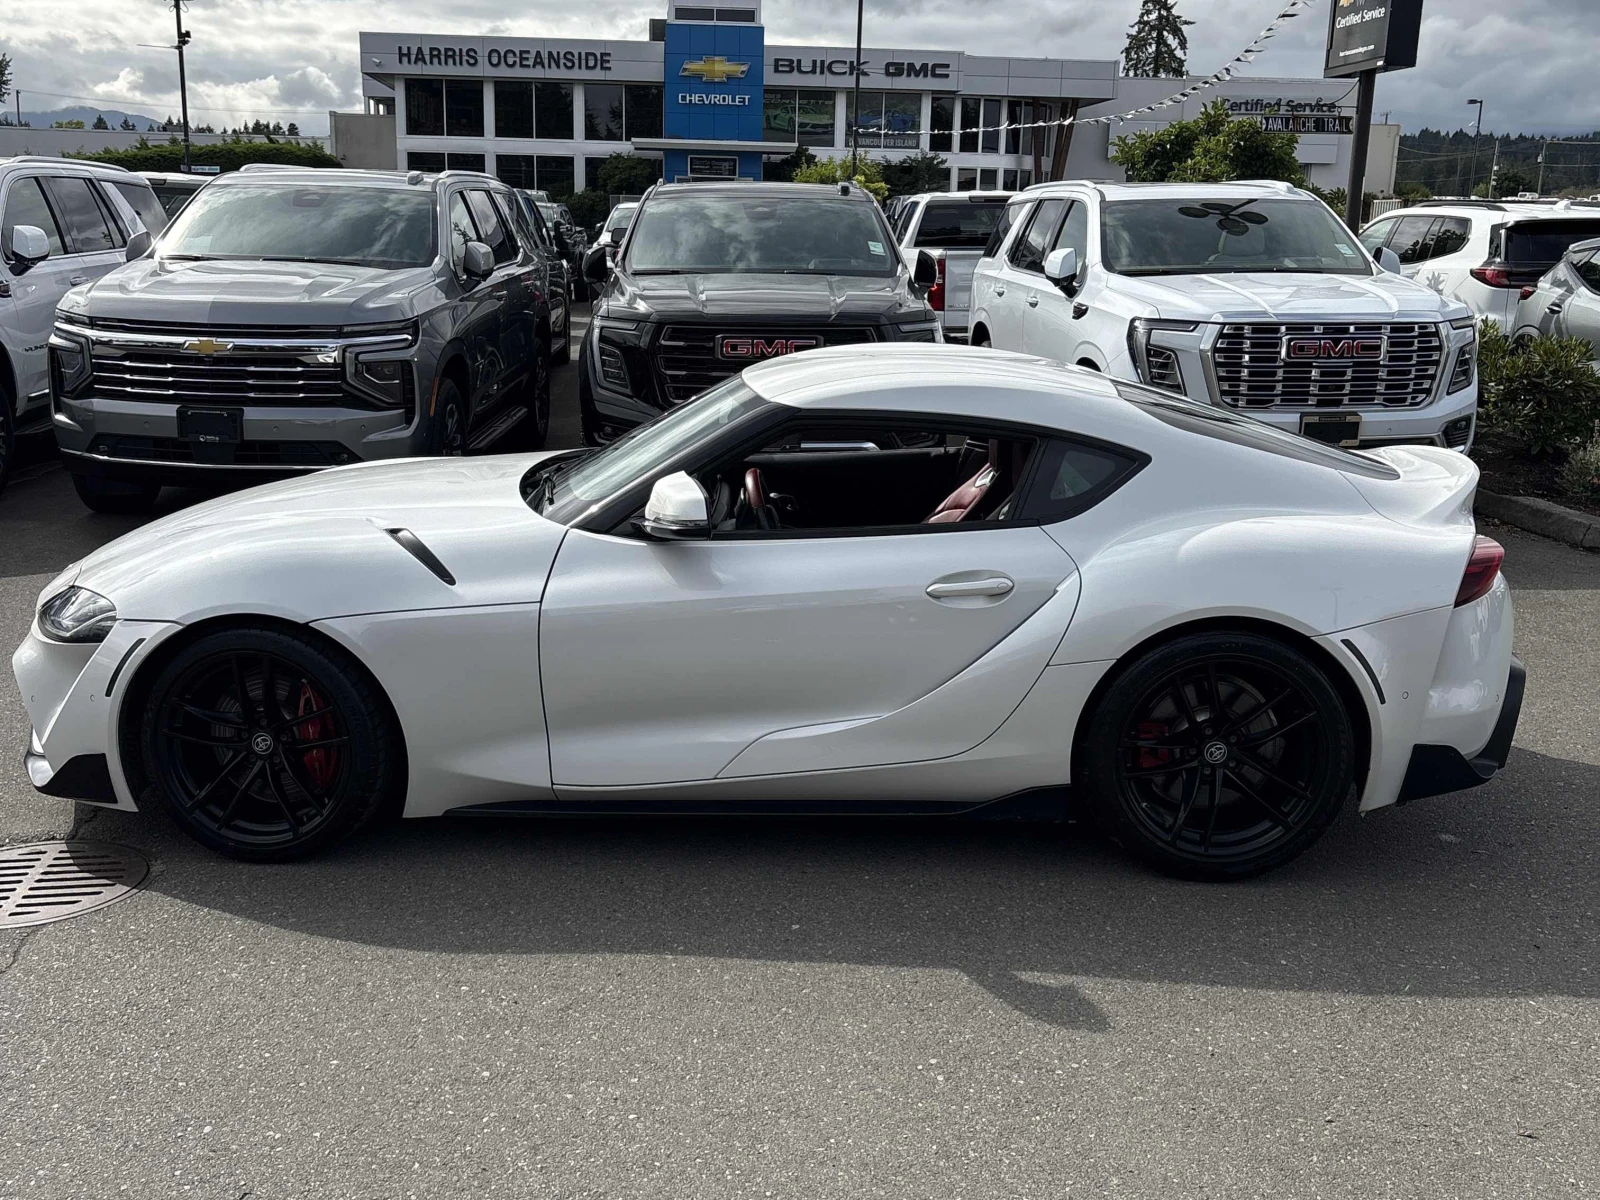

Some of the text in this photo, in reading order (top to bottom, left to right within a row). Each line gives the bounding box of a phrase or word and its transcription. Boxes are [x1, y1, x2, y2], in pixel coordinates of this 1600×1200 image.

[1336, 6, 1386, 29] Certified Service
[397, 45, 612, 71] HARRIS OCEANSIDE
[773, 57, 950, 79] BUICK GMC
[678, 93, 751, 106] CHEVROLET
[1223, 98, 1337, 113] Certified Service
[1267, 117, 1348, 132] AVALANCHE TRAIL
[895, 139, 917, 147] ISLAND
[723, 339, 816, 357] GMC
[1290, 339, 1381, 357] GMC
